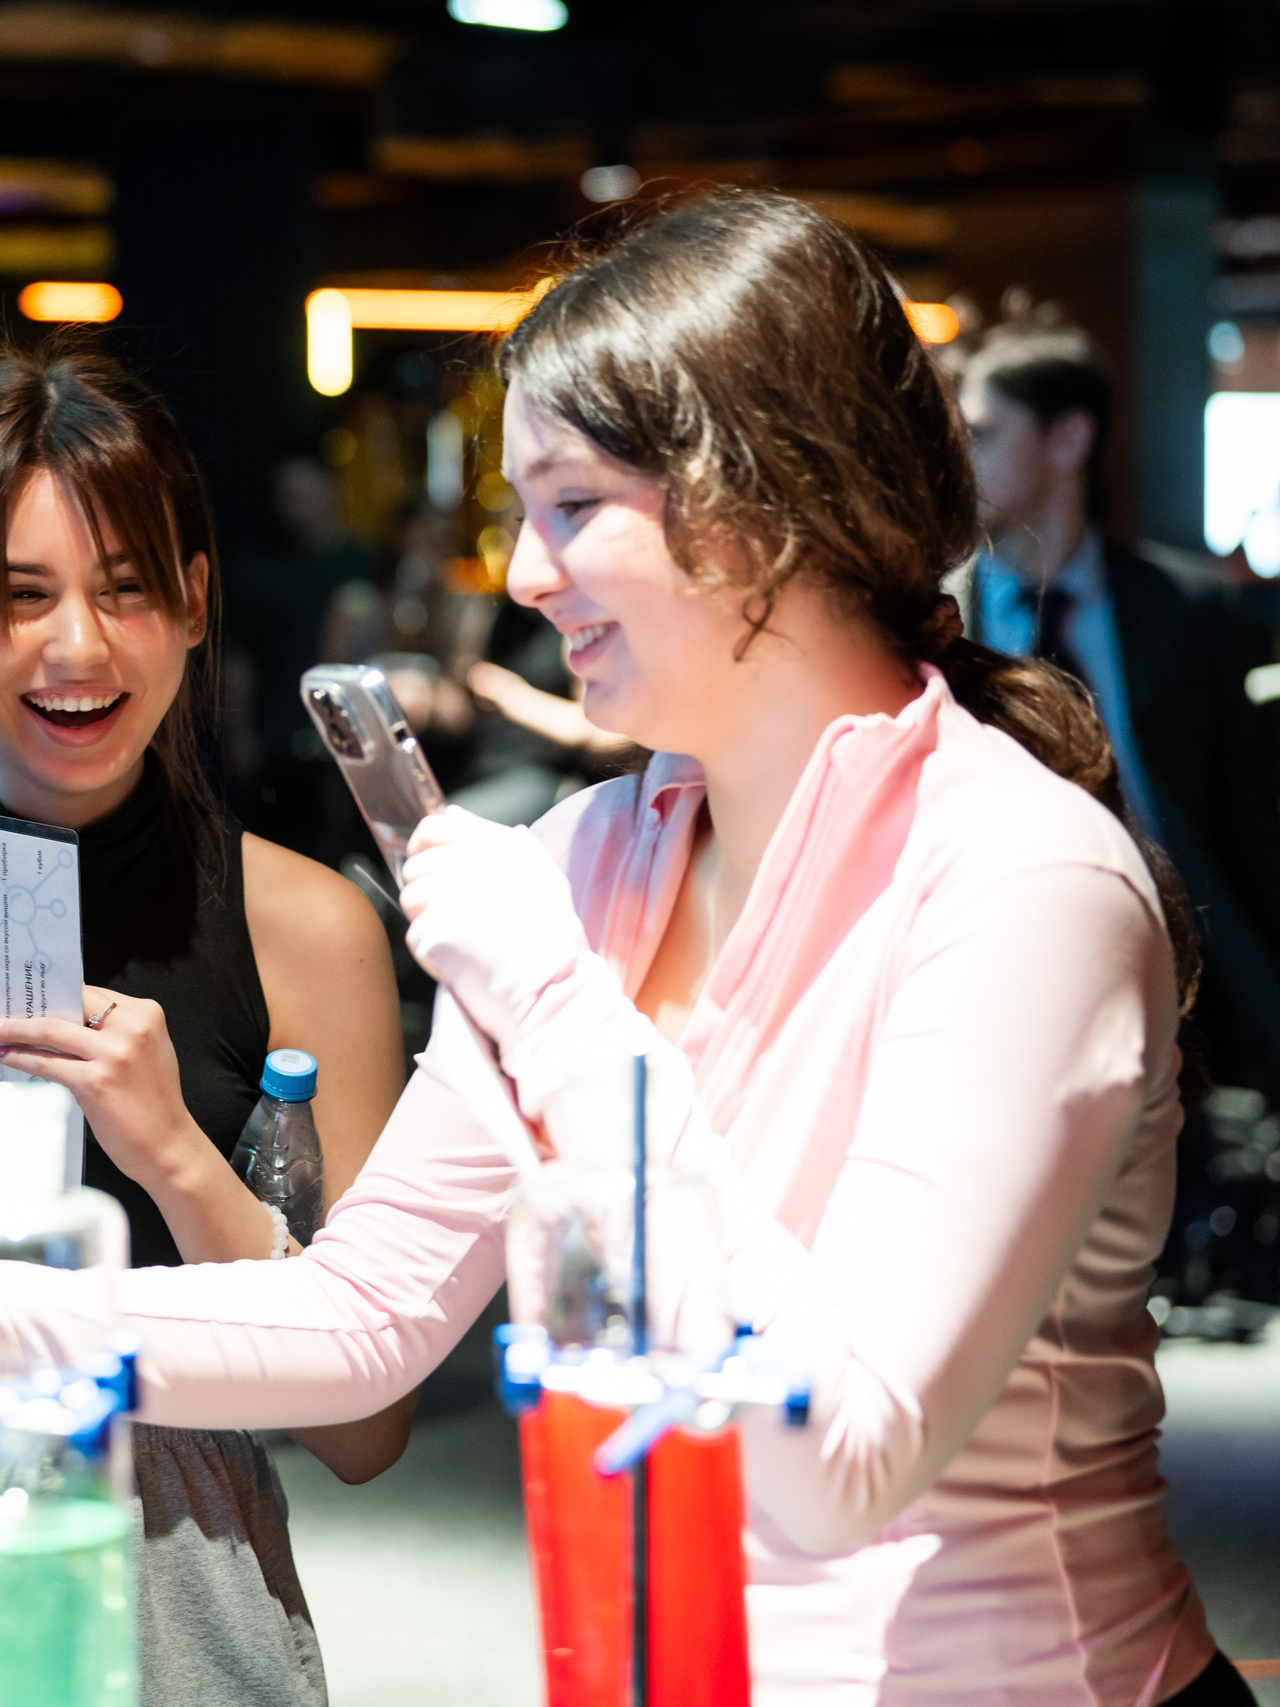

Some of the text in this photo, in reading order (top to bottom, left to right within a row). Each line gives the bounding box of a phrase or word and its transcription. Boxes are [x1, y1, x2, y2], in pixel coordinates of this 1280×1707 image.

[0, 842, 9, 877] пробирка
[36, 850, 44, 870] кубик
[4, 945, 9, 954] со
[24, 960, 34, 1020] КРАШЕНИЕ:
[40, 979, 46, 988] во
